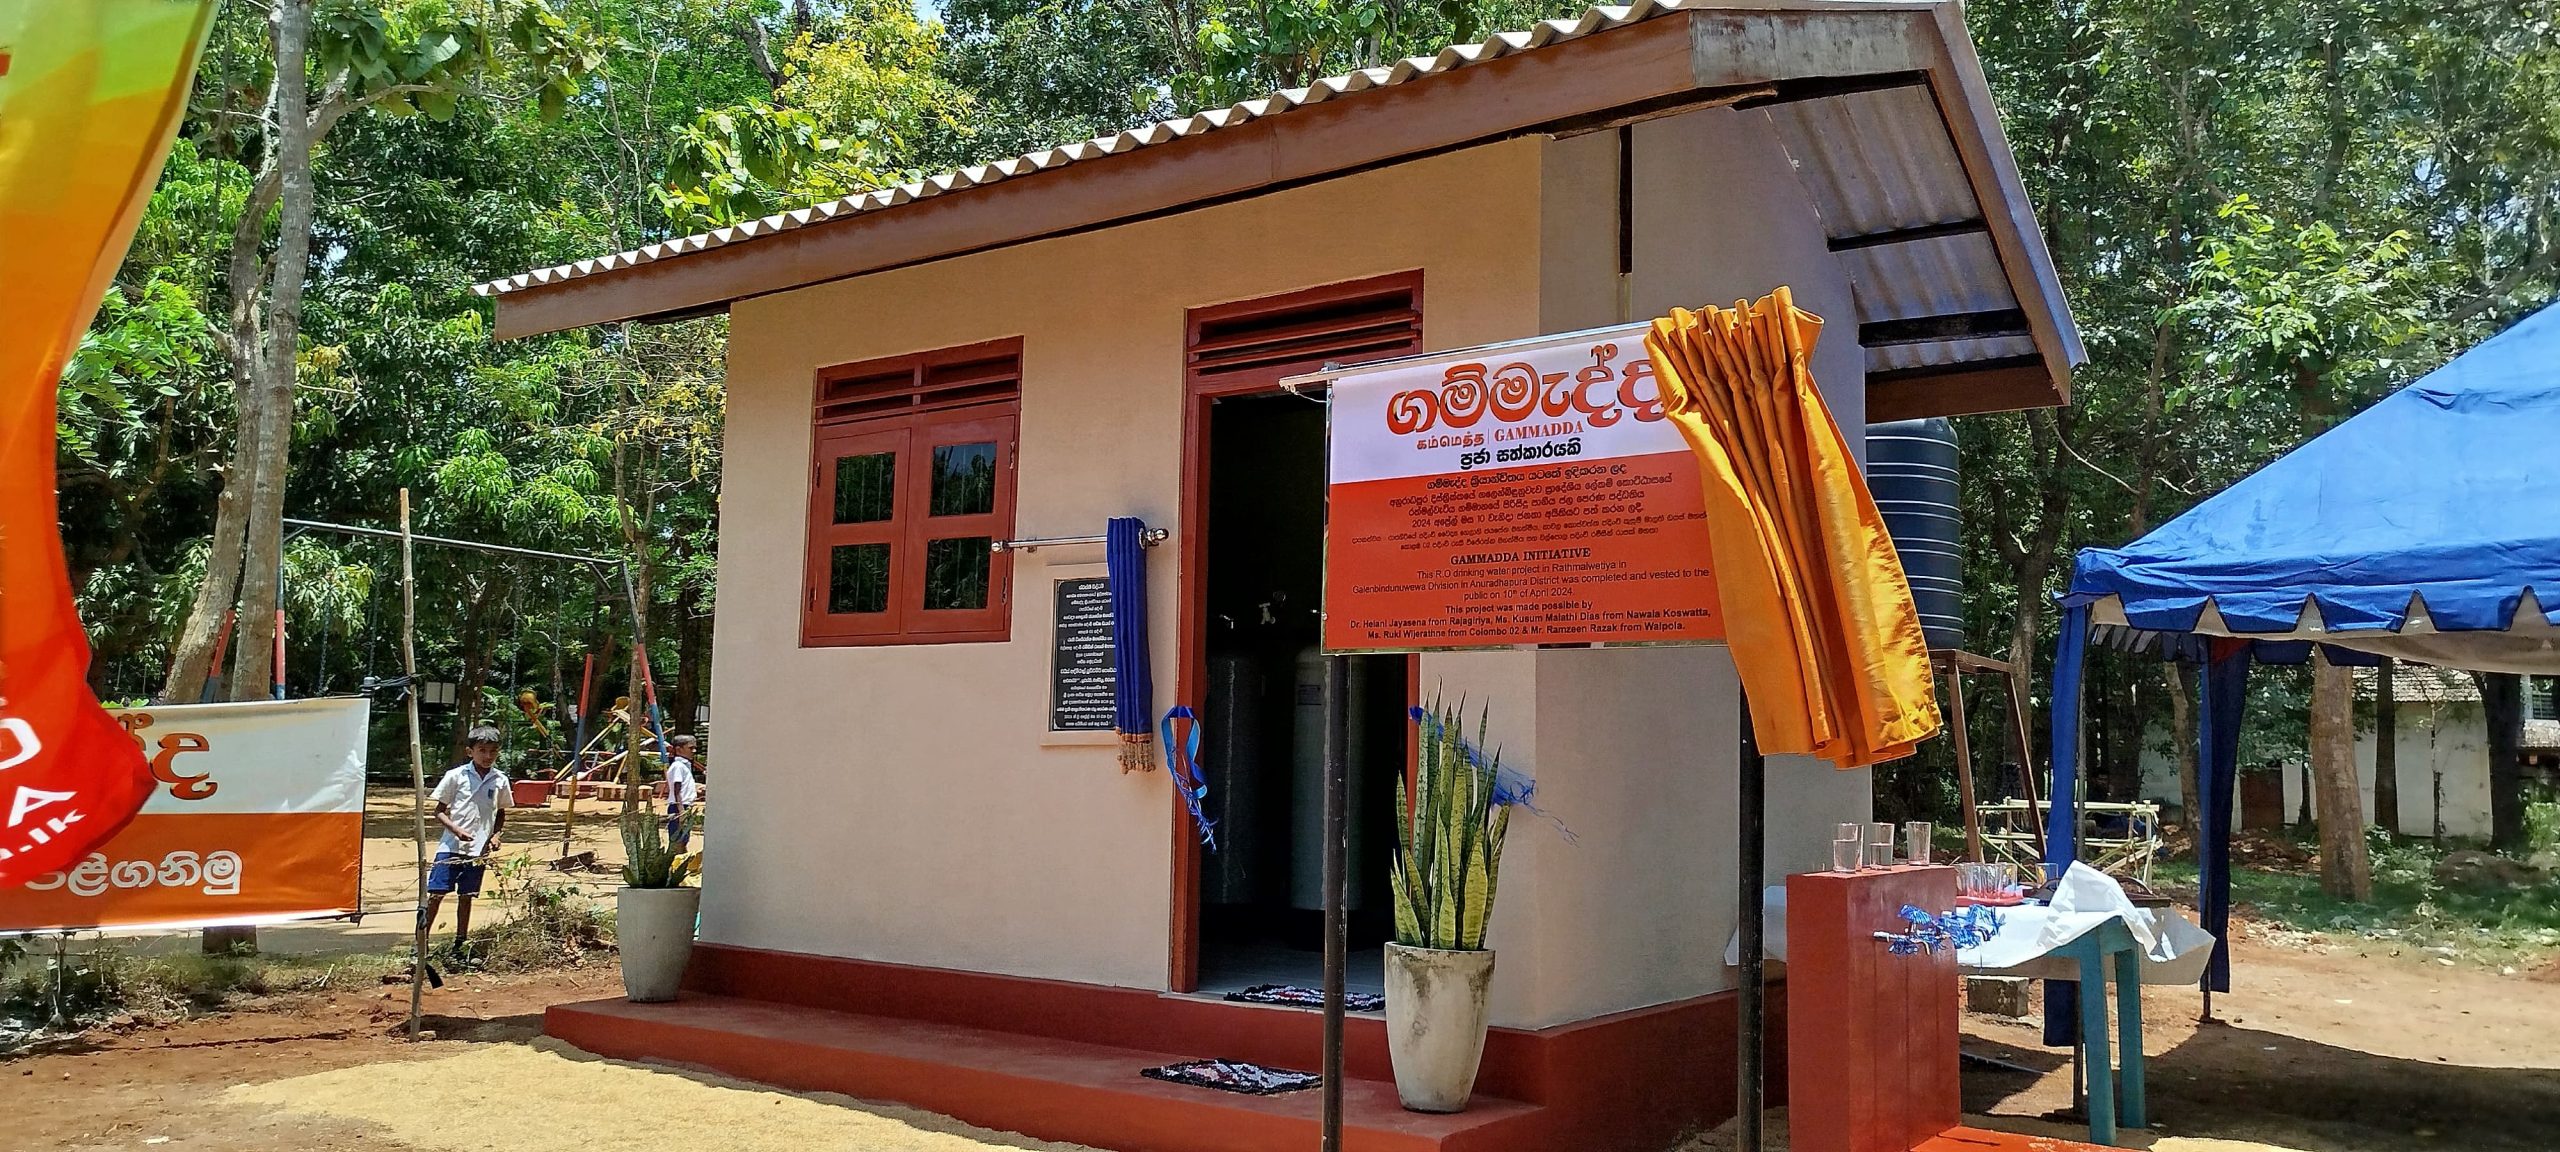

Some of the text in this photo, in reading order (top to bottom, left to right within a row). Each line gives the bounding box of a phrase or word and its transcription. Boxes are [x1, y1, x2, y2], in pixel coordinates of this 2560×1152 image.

[1494, 420, 1584, 442] GAMMADDA
[1412, 519, 1431, 528] 2024
[1477, 514, 1485, 522] 10
[1451, 547, 1591, 565] GAMMADDA INITIATIVE
[1417, 570, 1433, 579] This
[1453, 568, 1484, 578] drinking
[1487, 567, 1509, 576] water
[1512, 564, 1540, 576] project
[1542, 565, 1549, 573] in
[1619, 560, 1627, 568] in
[1428, 581, 1459, 590] Division
[1461, 580, 1468, 588] in
[1470, 578, 1527, 589] Anuradhapura
[1530, 576, 1559, 585] District
[1561, 576, 1579, 584] was
[1582, 572, 1627, 584] completed
[1630, 571, 1647, 580] and
[1649, 569, 1680, 579] vested
[1682, 569, 1691, 578] to
[1694, 568, 1709, 577] the
[1464, 591, 1488, 601] public
[1520, 589, 1528, 597] of
[1530, 588, 1549, 598] April
[1446, 600, 1593, 614] This project was made possible by
[1350, 620, 1361, 629] Dr.
[1363, 619, 1387, 628] Helani
[1389, 619, 1426, 629] Jayasena
[1428, 618, 1447, 626] from
[1512, 614, 1543, 623] Kusum
[1545, 612, 1577, 622] Malathi
[1580, 612, 1600, 620] Dias
[1602, 610, 1623, 620] from
[1626, 610, 1660, 619] Nawala
[1663, 608, 1711, 618] Koswatta,
[1383, 630, 1400, 639] Ruki
[1402, 629, 1445, 640] Wijerathne
[1448, 628, 1467, 637] from
[1469, 627, 1507, 636] Colombo
[1509, 626, 1519, 635] 02
[1522, 626, 1528, 635] &
[1547, 625, 1587, 634] Ramzeen
[1590, 623, 1617, 632] Razak
[1620, 623, 1642, 632] from
[1644, 620, 1686, 632] Walpola.
